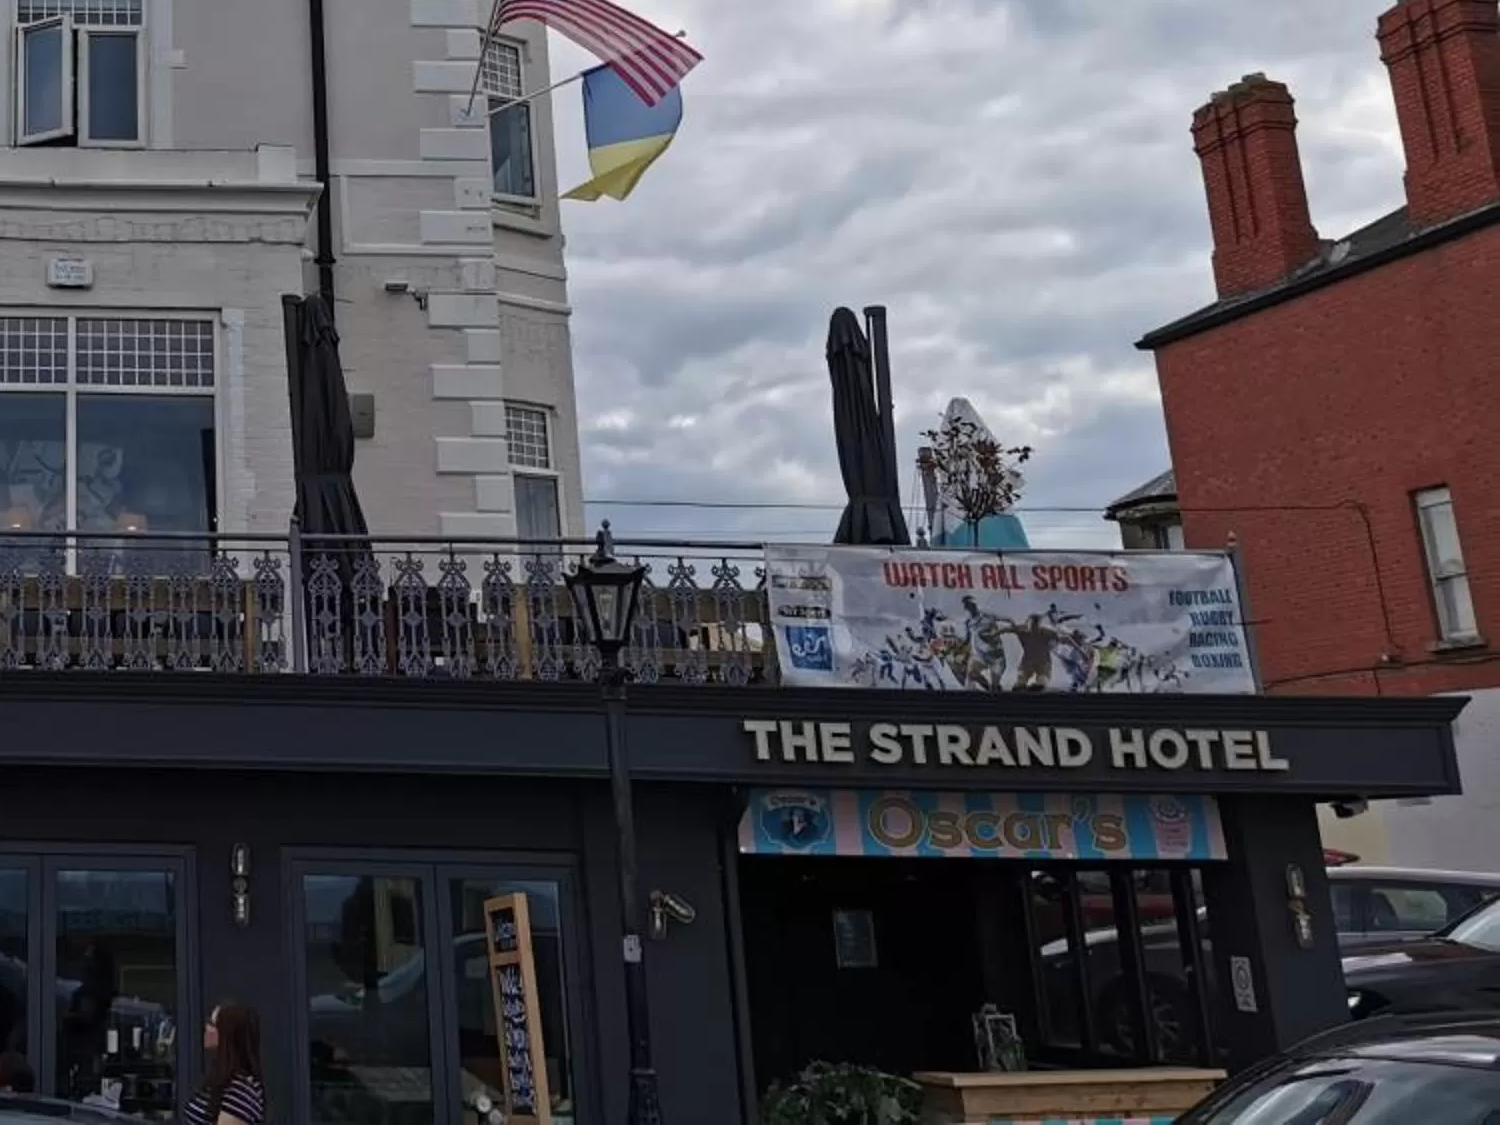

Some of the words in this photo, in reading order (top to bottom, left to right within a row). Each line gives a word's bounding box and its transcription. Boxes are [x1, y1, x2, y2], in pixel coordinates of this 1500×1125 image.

[883, 562, 973, 589] WATCH
[980, 563, 1026, 591] ALL
[1031, 565, 1129, 592] SPORTS
[1169, 589, 1233, 605] FOOTBALL
[1189, 610, 1233, 627] RUGBY
[1189, 632, 1239, 648] RACING
[1191, 653, 1243, 668] BOXING
[743, 720, 855, 764] THE
[870, 724, 1093, 768] STRAND
[1109, 727, 1290, 772] HOTEL
[867, 794, 1130, 852] Oscar's
